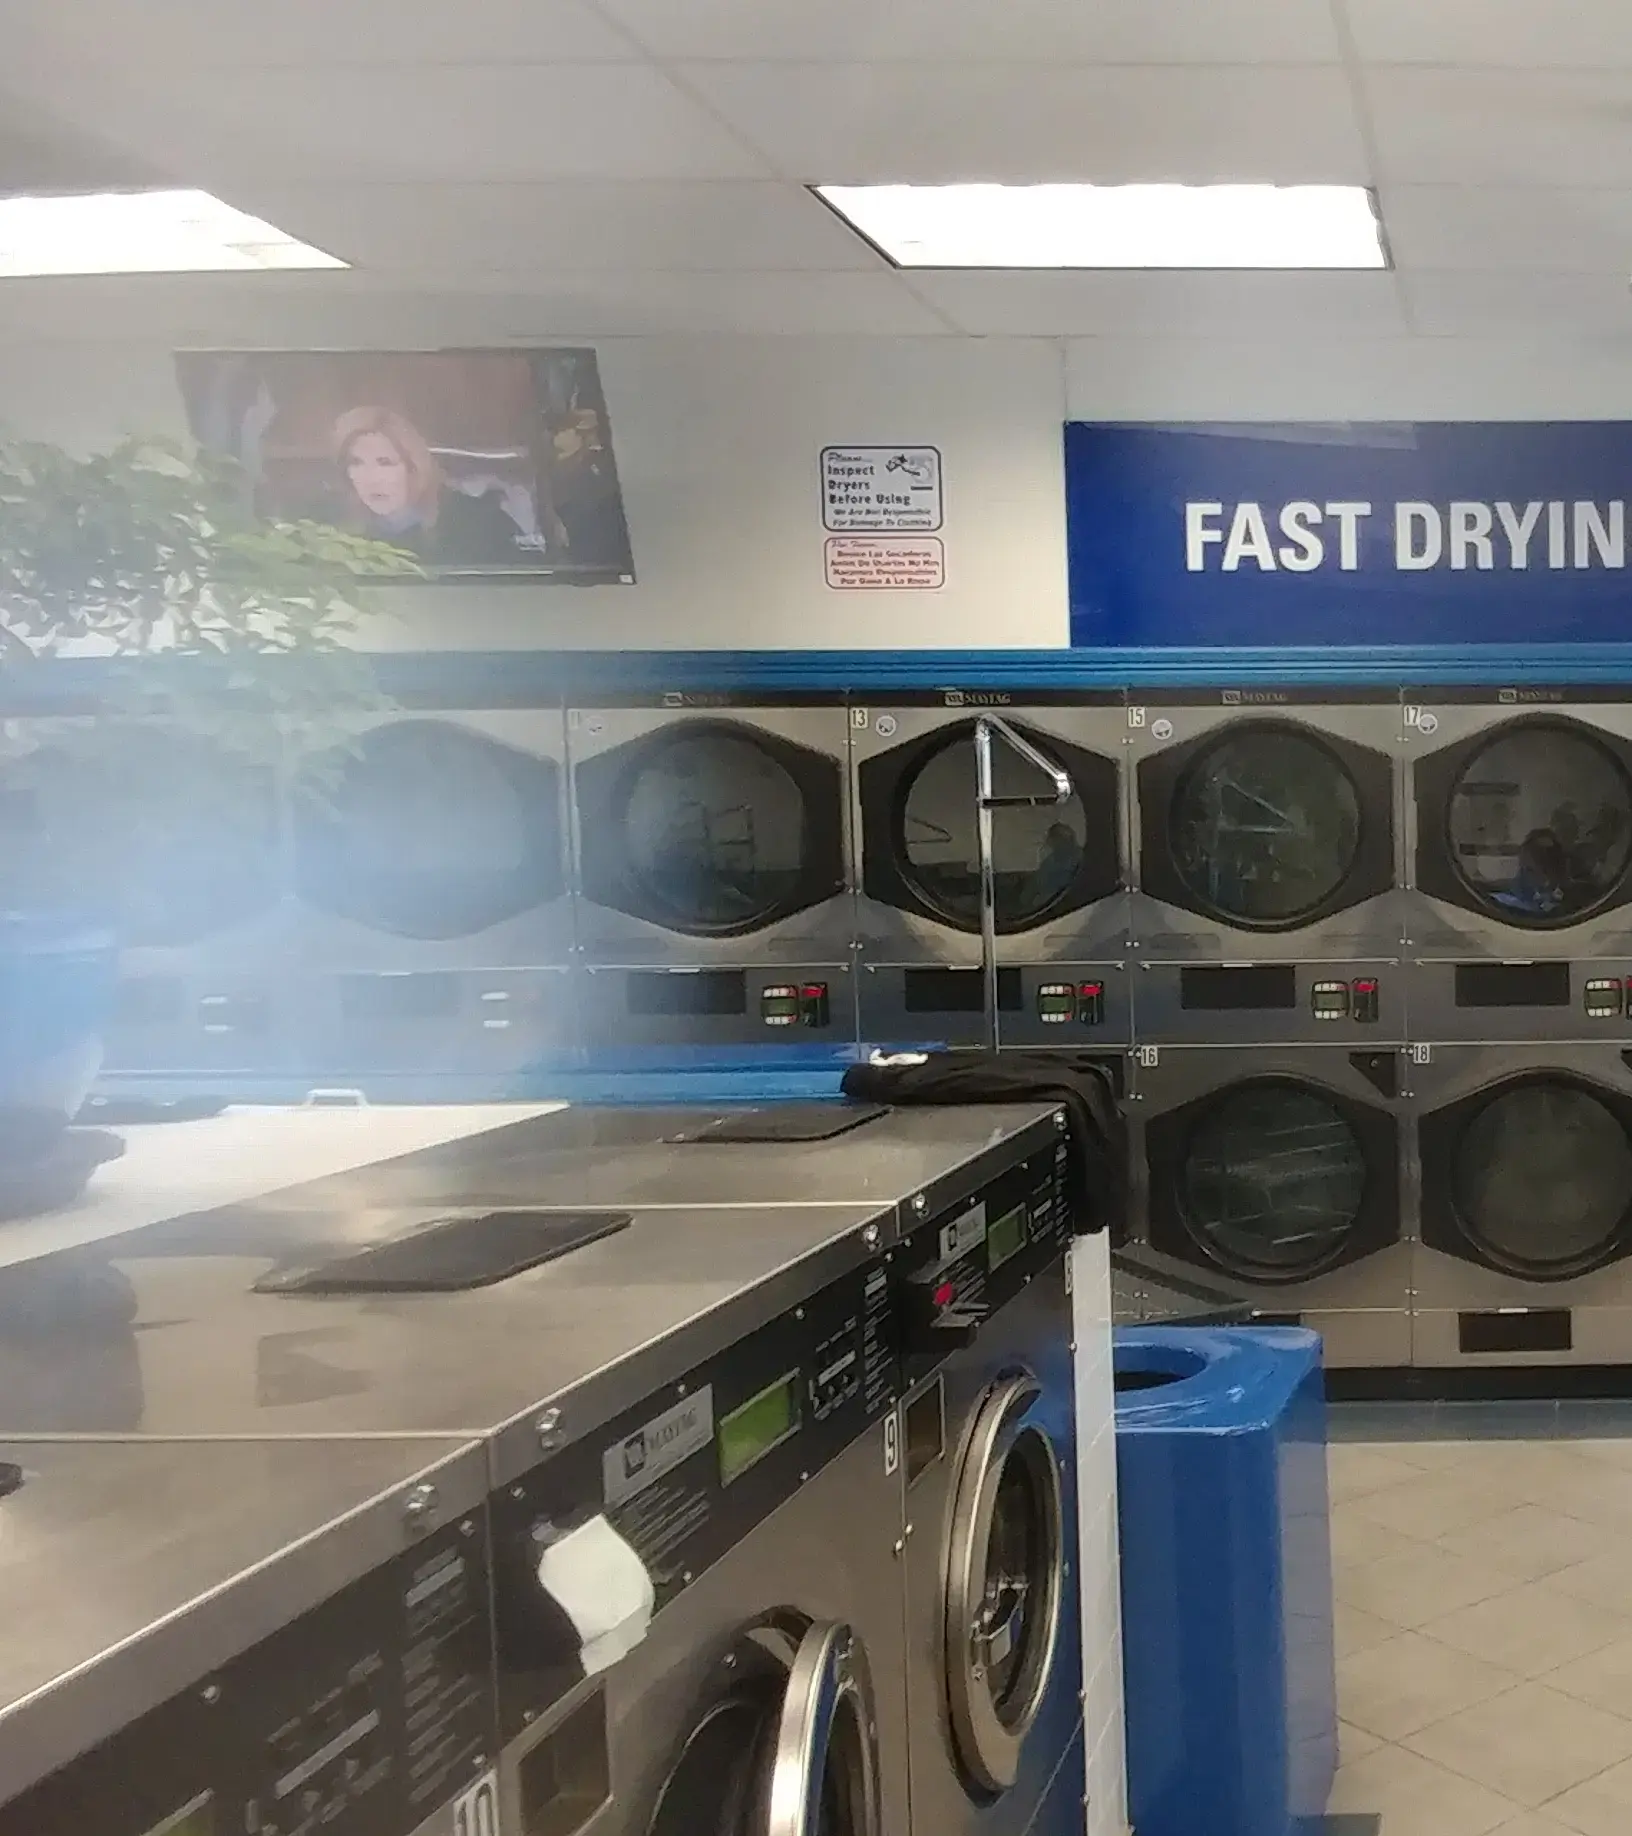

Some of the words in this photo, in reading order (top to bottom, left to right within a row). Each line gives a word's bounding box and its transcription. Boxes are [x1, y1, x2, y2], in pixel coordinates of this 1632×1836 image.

[828, 464, 875, 477] Inspect
[828, 480, 870, 492] Dryers
[829, 494, 872, 504] Before
[876, 493, 911, 506] Using
[1185, 501, 1372, 572] FAST
[852, 709, 866, 726] 13
[1129, 708, 1143, 725] 15
[1405, 706, 1419, 723] 17
[1142, 1048, 1156, 1064] 16
[1414, 1045, 1428, 1061] 18
[887, 1418, 896, 1468] 9
